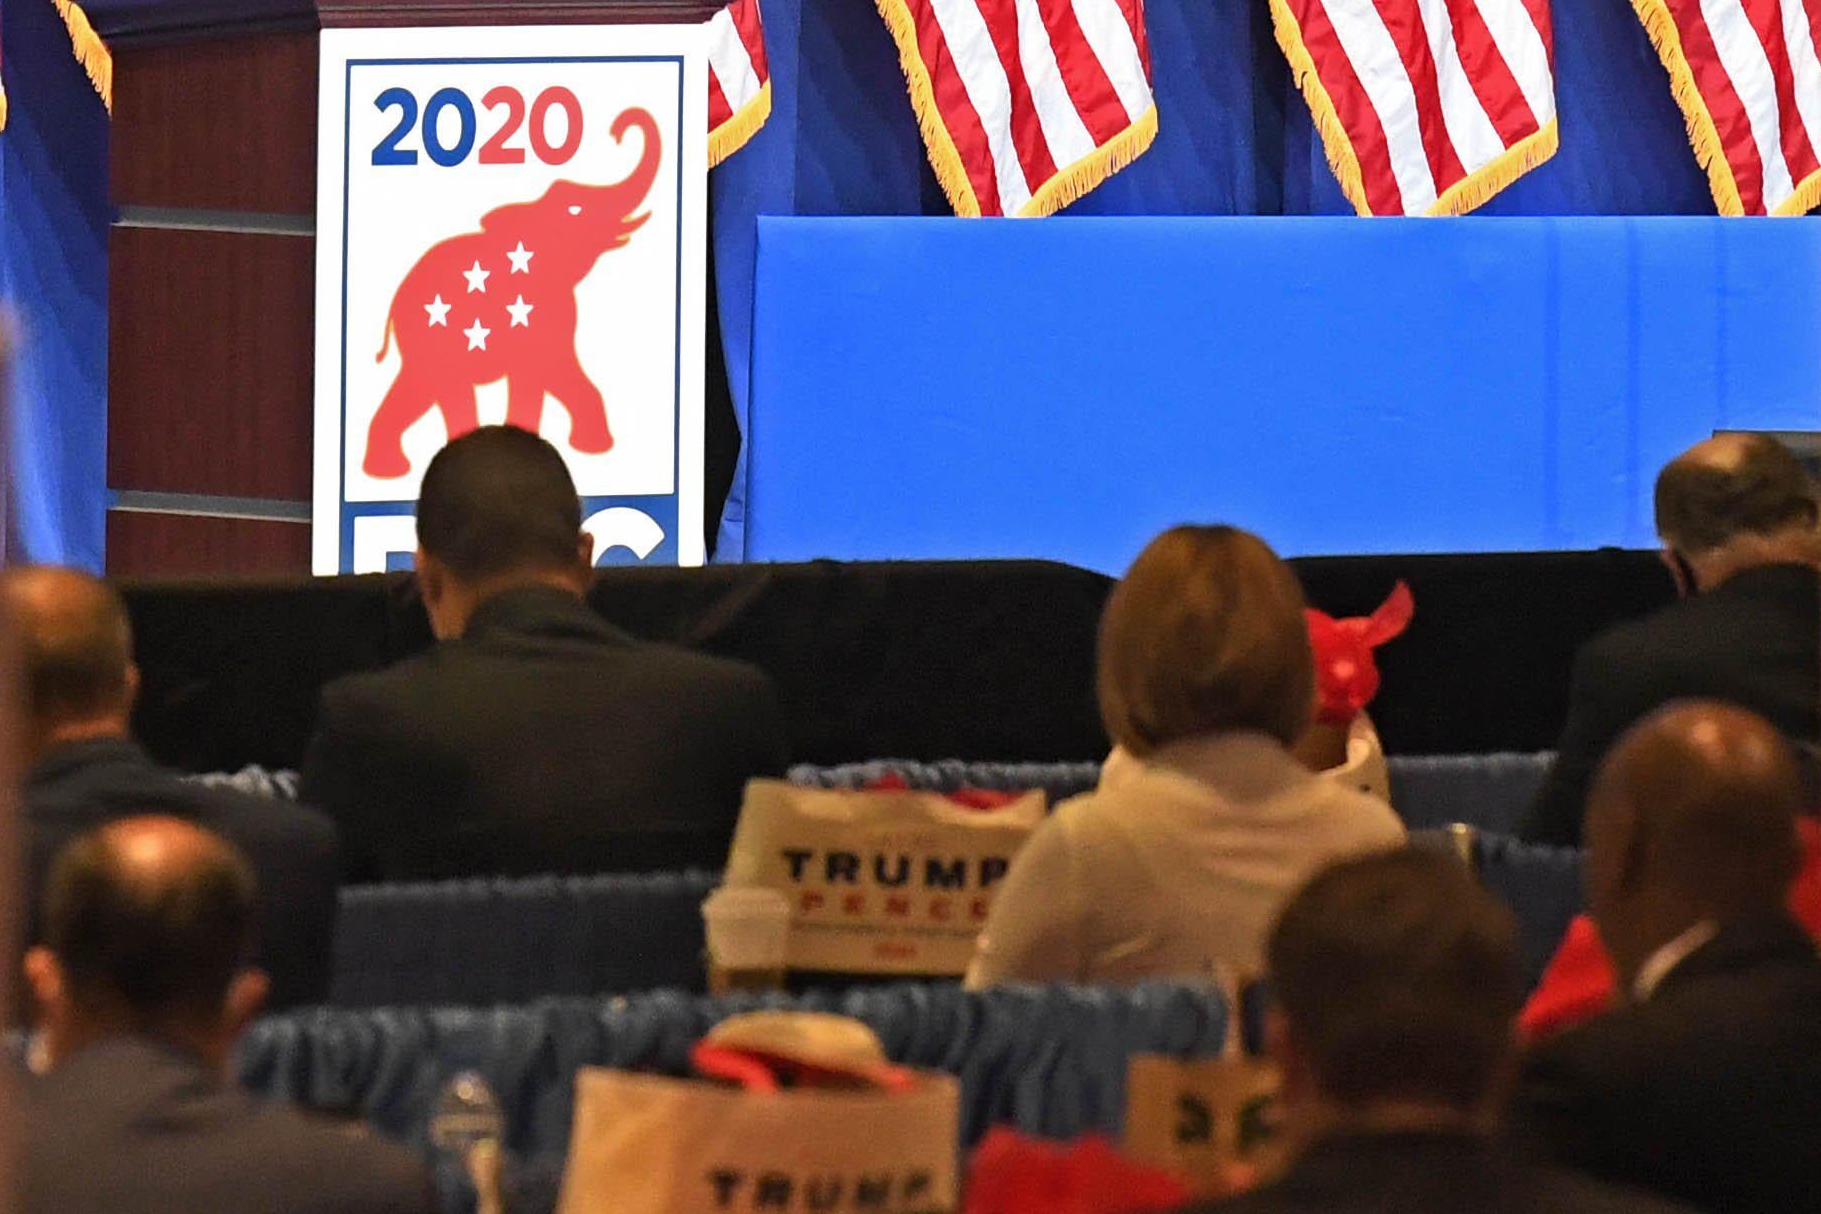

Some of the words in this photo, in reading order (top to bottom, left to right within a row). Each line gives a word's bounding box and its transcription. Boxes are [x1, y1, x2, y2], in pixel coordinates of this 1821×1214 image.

[371, 85, 584, 167] 2020
[782, 849, 1009, 889] TRUMP
[709, 1168, 932, 1208] TRUMP
